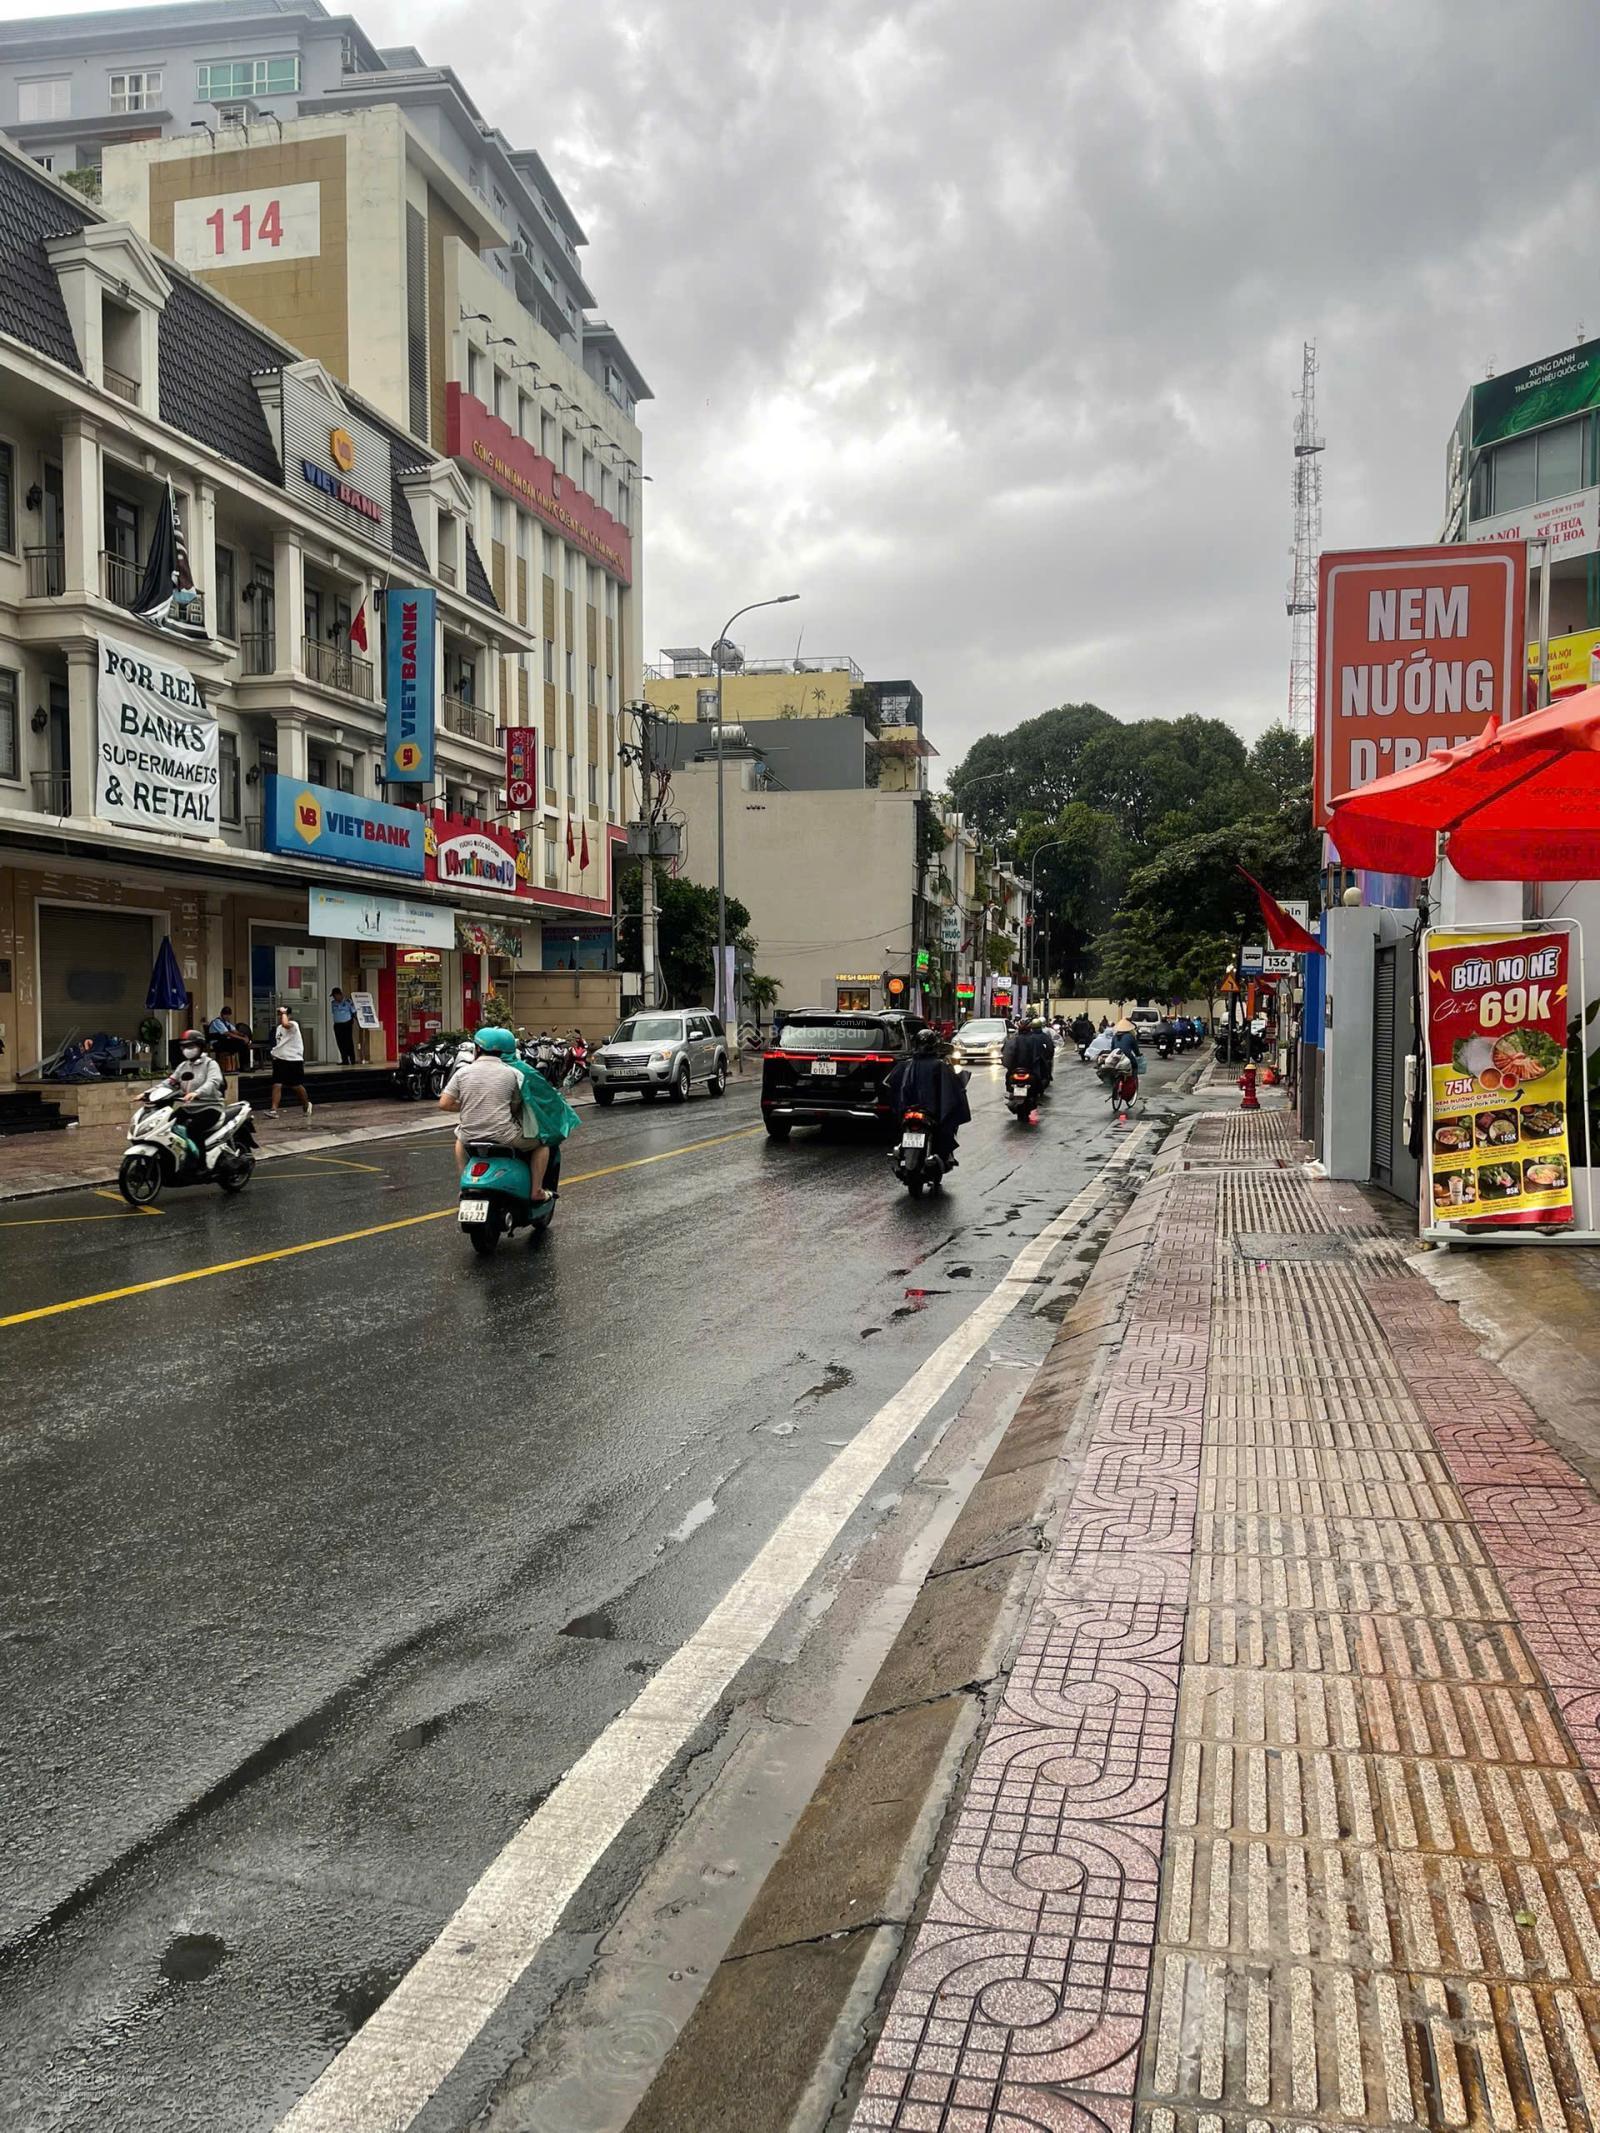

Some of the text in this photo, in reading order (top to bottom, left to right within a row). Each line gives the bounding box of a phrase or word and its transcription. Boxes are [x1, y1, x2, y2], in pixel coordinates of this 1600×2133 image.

[206, 200, 284, 255] 114
[1553, 353, 1576, 369] DANH
[1577, 360, 1590, 370] GIA
[472, 439, 494, 467] CÔNG
[302, 458, 384, 525] VIETBANK
[1368, 585, 1469, 642] NEM
[105, 650, 154, 692] FOR
[401, 601, 418, 738] VIETBANK
[1341, 648, 1494, 718] NƯỚNG
[120, 703, 206, 752] BANKS
[102, 742, 217, 785] SUPERMAKETS
[1349, 736, 1478, 790] D'R
[105, 775, 215, 822] & RETAIL
[325, 810, 411, 849] VIETBANK
[1268, 958, 1288, 967] 136
[1453, 961, 1493, 990] BỮA
[1498, 957, 1524, 983] NO
[1480, 984, 1552, 1028] 69k
[1446, 1078, 1473, 1096] 75K
